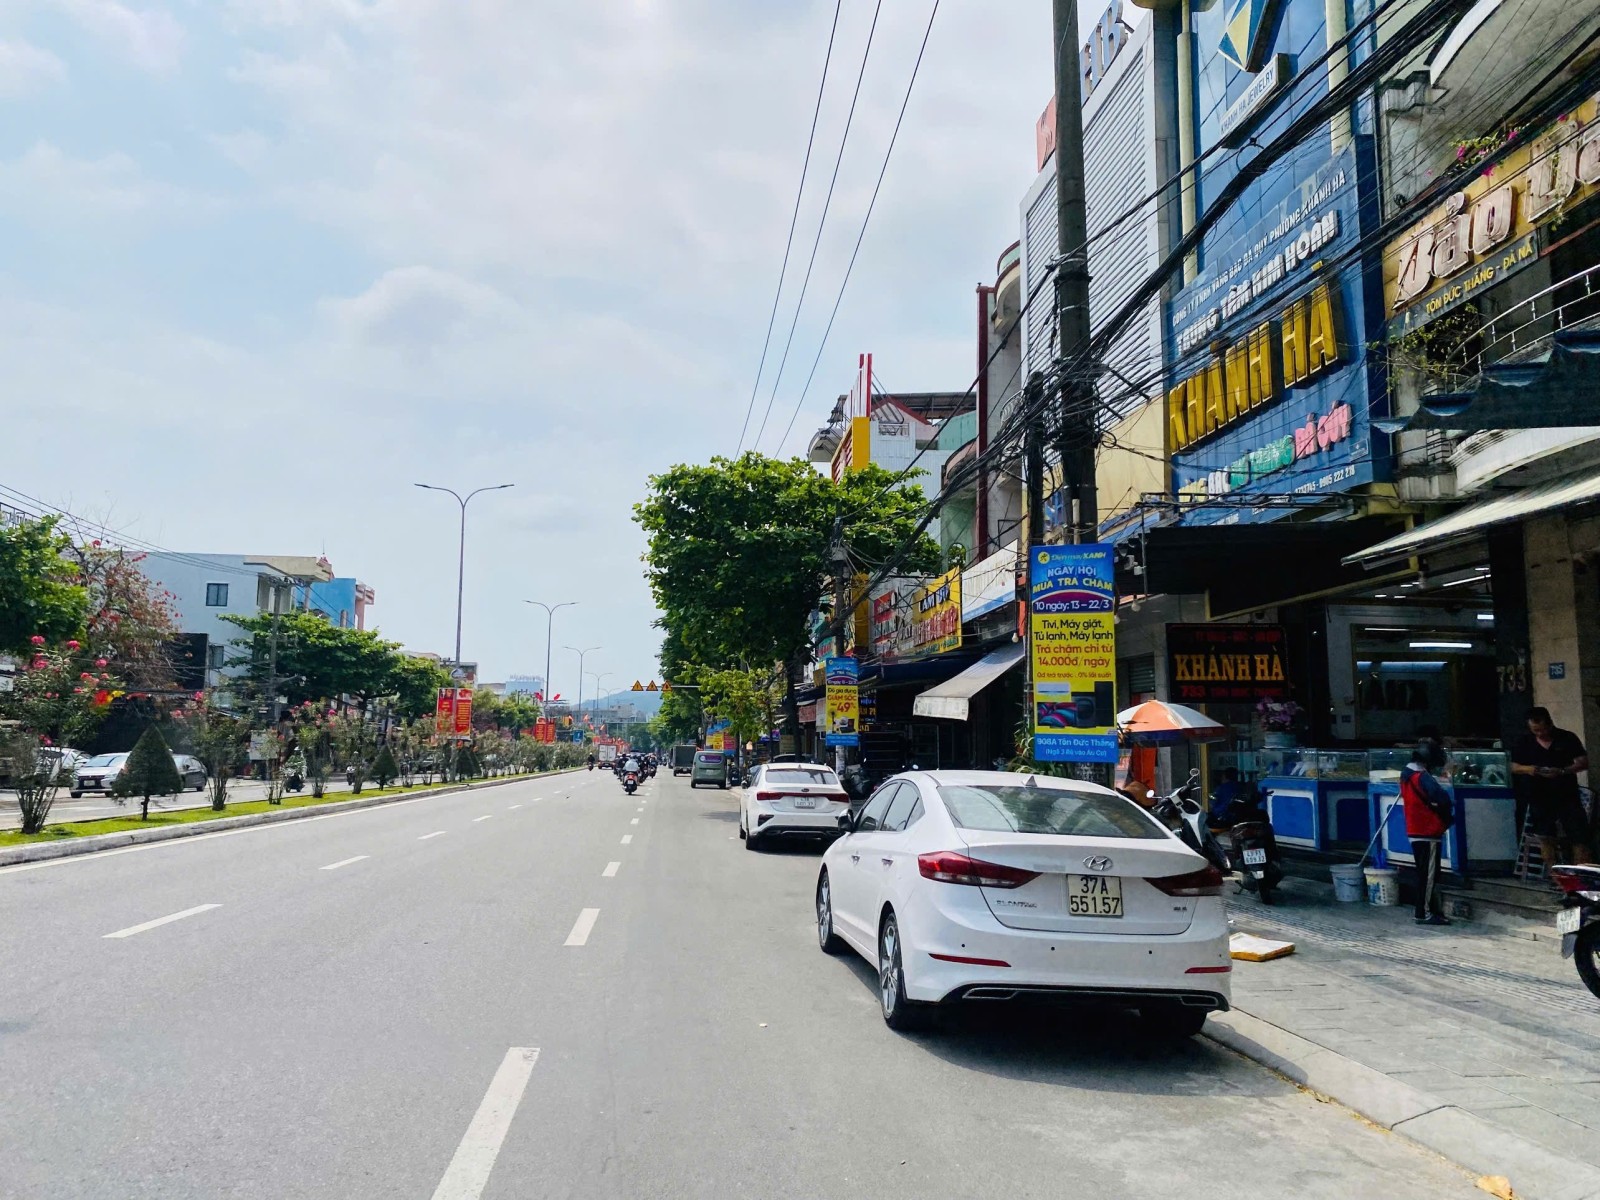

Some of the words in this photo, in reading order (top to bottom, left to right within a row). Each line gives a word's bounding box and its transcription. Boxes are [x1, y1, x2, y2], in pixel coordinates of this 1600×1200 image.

[1247, 67, 1274, 106] JEWELRY
[1426, 296, 1442, 314] TÔN
[1443, 285, 1462, 306] ĐỨC
[1463, 267, 1495, 292] THẮNG
[1503, 253, 1517, 270] ĐÀ
[1032, 581, 1053, 594] MUA
[1035, 601, 1045, 610] 10
[1046, 601, 1070, 612] ngày:
[1070, 600, 1080, 609] 13
[1088, 599, 1110, 609] 22/3
[1042, 619, 1059, 630] Tivi,
[1060, 619, 1081, 630] Máy
[1082, 619, 1105, 631] giặt,
[1034, 631, 1045, 641] Tủ
[1046, 631, 1069, 643] lạnh,
[1069, 631, 1091, 642] Máy
[1092, 630, 1114, 643] lạnh
[1174, 645, 1252, 681] KHÁNH
[1254, 644, 1285, 681] HÀ
[1496, 665, 1527, 693] 733
[1058, 738, 1072, 746] Tôn
[1072, 738, 1090, 747] Đức
[1090, 738, 1115, 749] Thắng
[1080, 876, 1108, 895] 37A
[1070, 895, 1120, 915] 551.57
